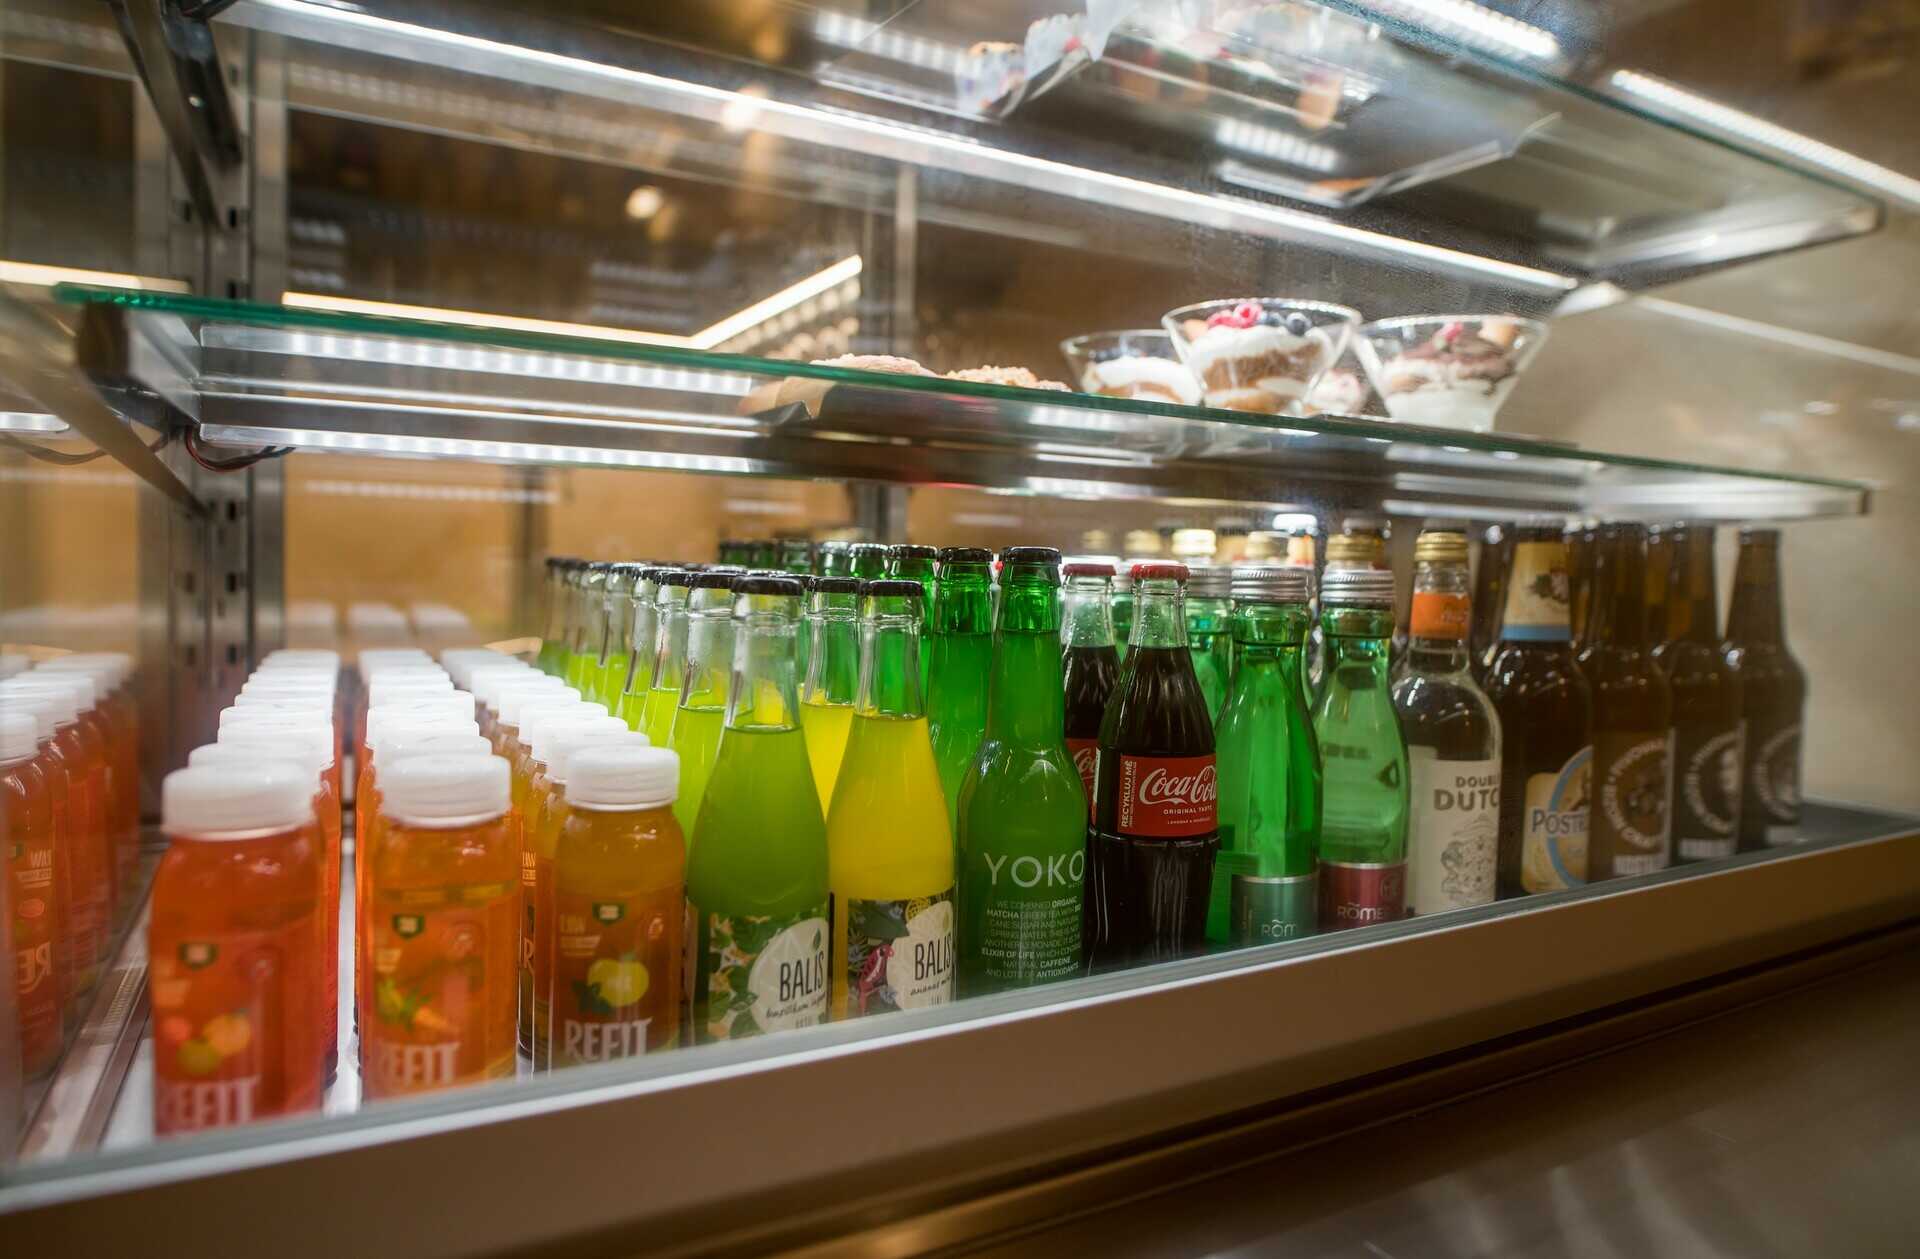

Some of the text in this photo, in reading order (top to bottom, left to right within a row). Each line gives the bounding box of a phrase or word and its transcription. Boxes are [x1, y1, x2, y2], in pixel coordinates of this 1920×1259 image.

[1121, 777, 1132, 828] RECYKLUJ
[1163, 807, 1197, 816] ORIGINAL
[983, 850, 1084, 888] YOKO
[986, 907, 1020, 919] MATCHA
[780, 951, 825, 1001] BALIS
